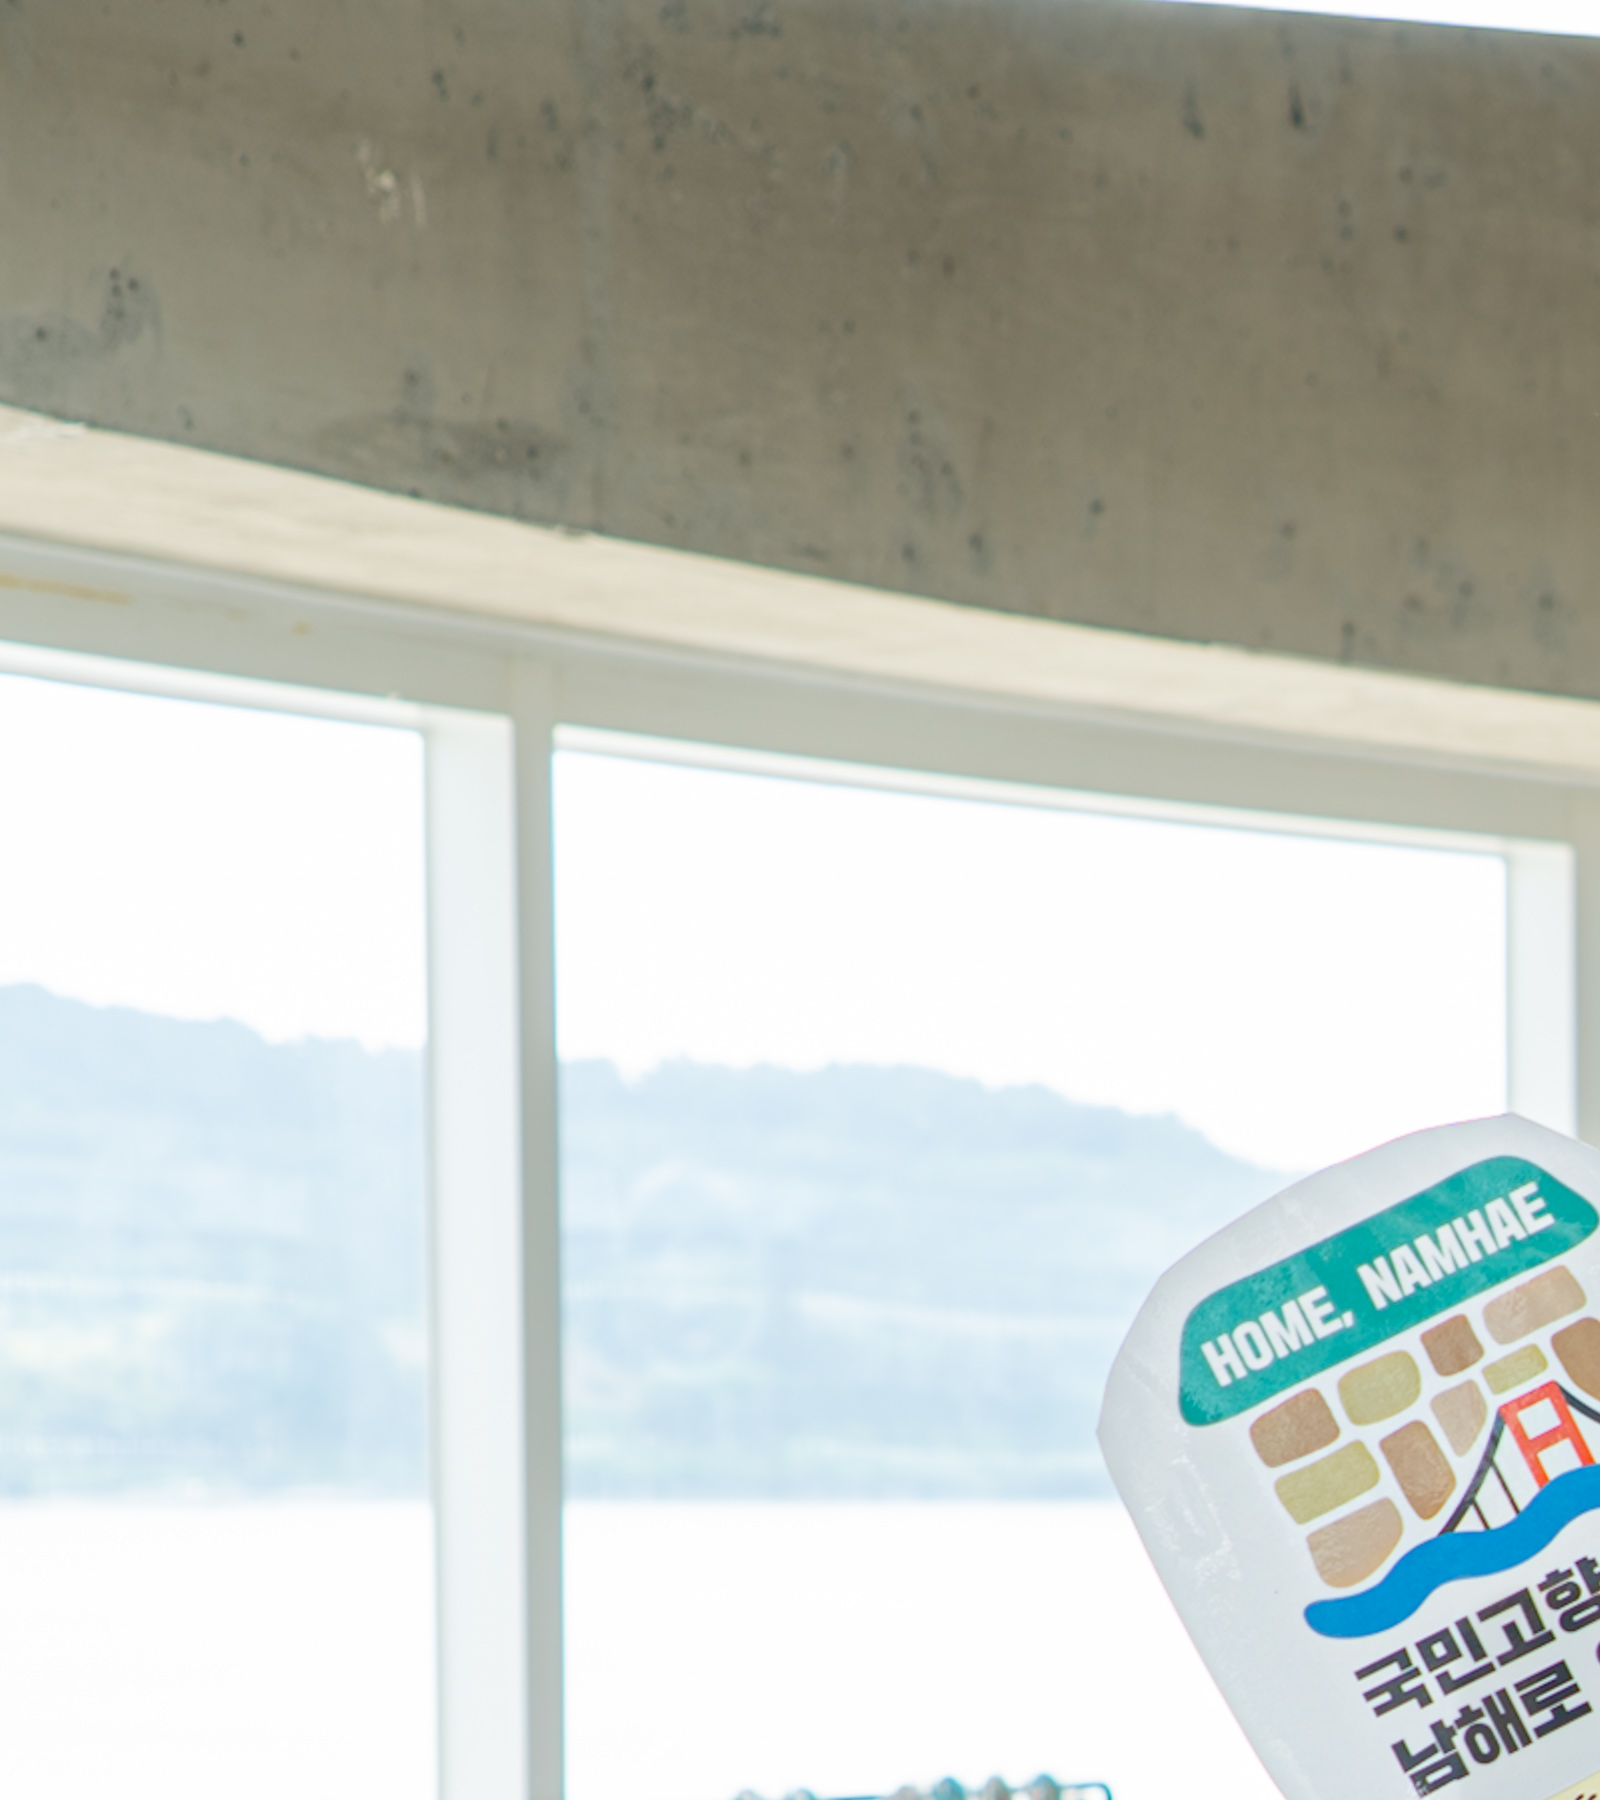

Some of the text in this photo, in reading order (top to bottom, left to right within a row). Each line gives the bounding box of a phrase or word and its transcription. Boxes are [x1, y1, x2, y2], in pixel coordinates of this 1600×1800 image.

[1200, 1182, 1555, 1388] HOME, NAMHAE
[1391, 1660, 1593, 1798] 남해로
